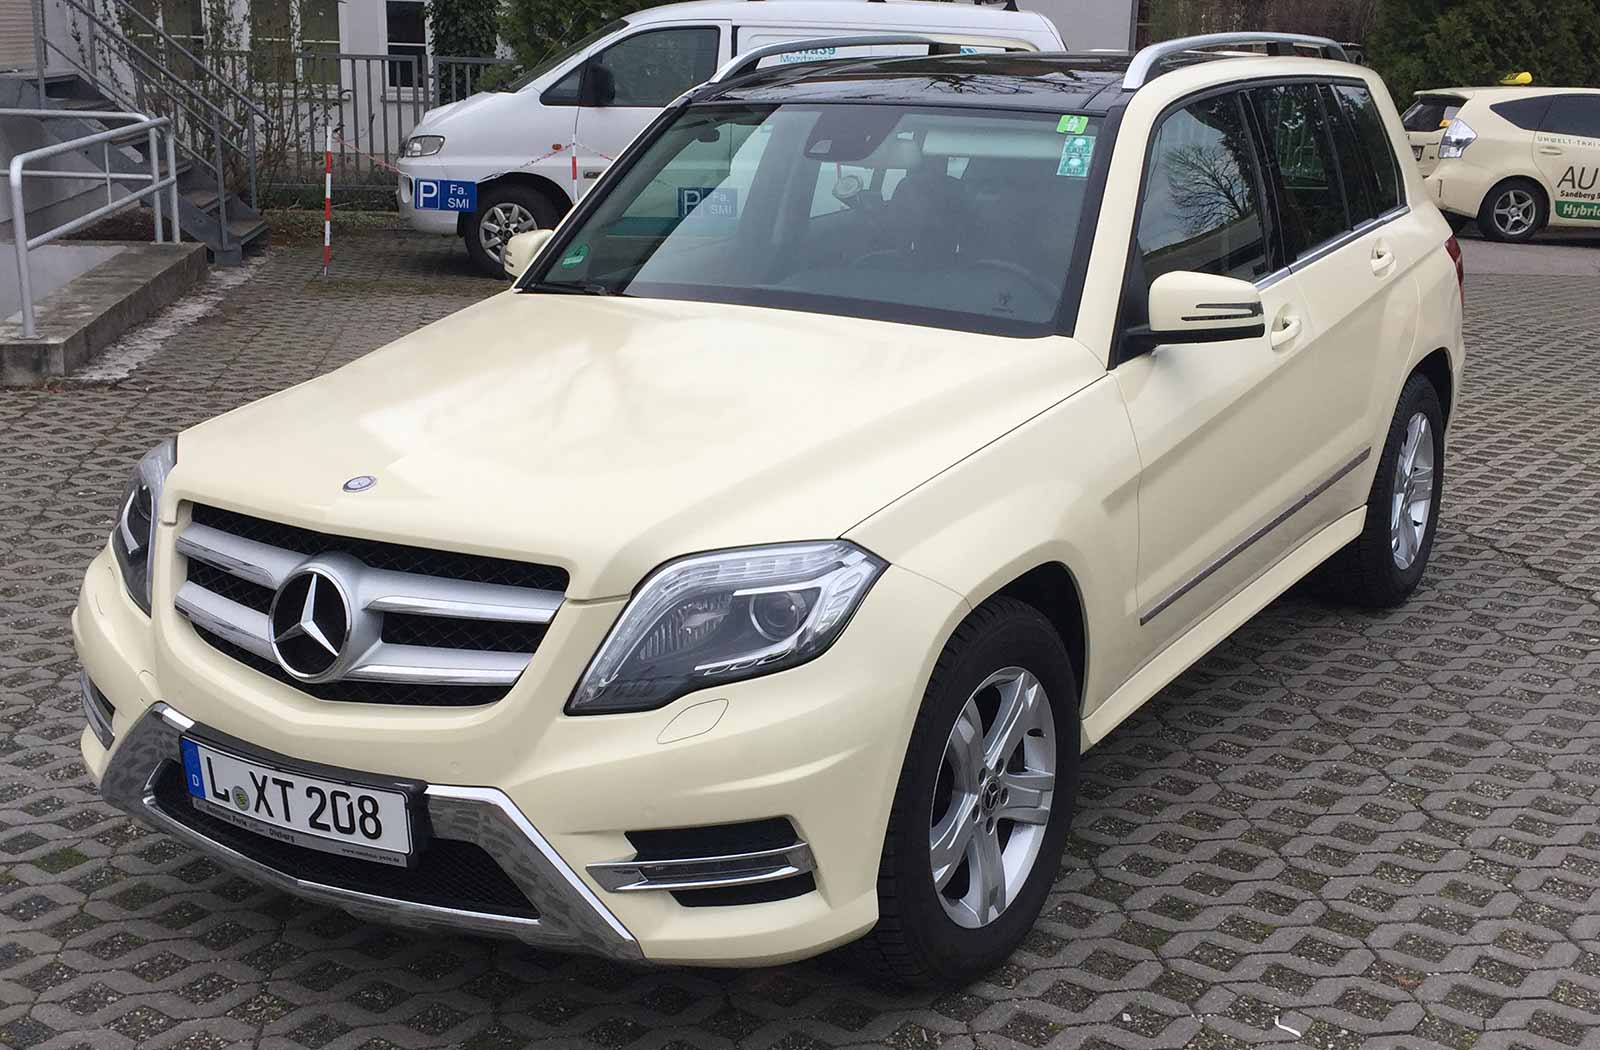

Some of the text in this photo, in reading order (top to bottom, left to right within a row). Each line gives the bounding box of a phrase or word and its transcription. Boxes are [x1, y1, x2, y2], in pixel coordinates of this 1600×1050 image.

[1557, 166, 1600, 190] AU
[420, 181, 437, 207] P
[449, 184, 468, 196] Fa.
[1560, 190, 1595, 200] Sandberg
[447, 197, 470, 209] SMI
[192, 774, 200, 787] D
[206, 756, 383, 840] L XT 208
